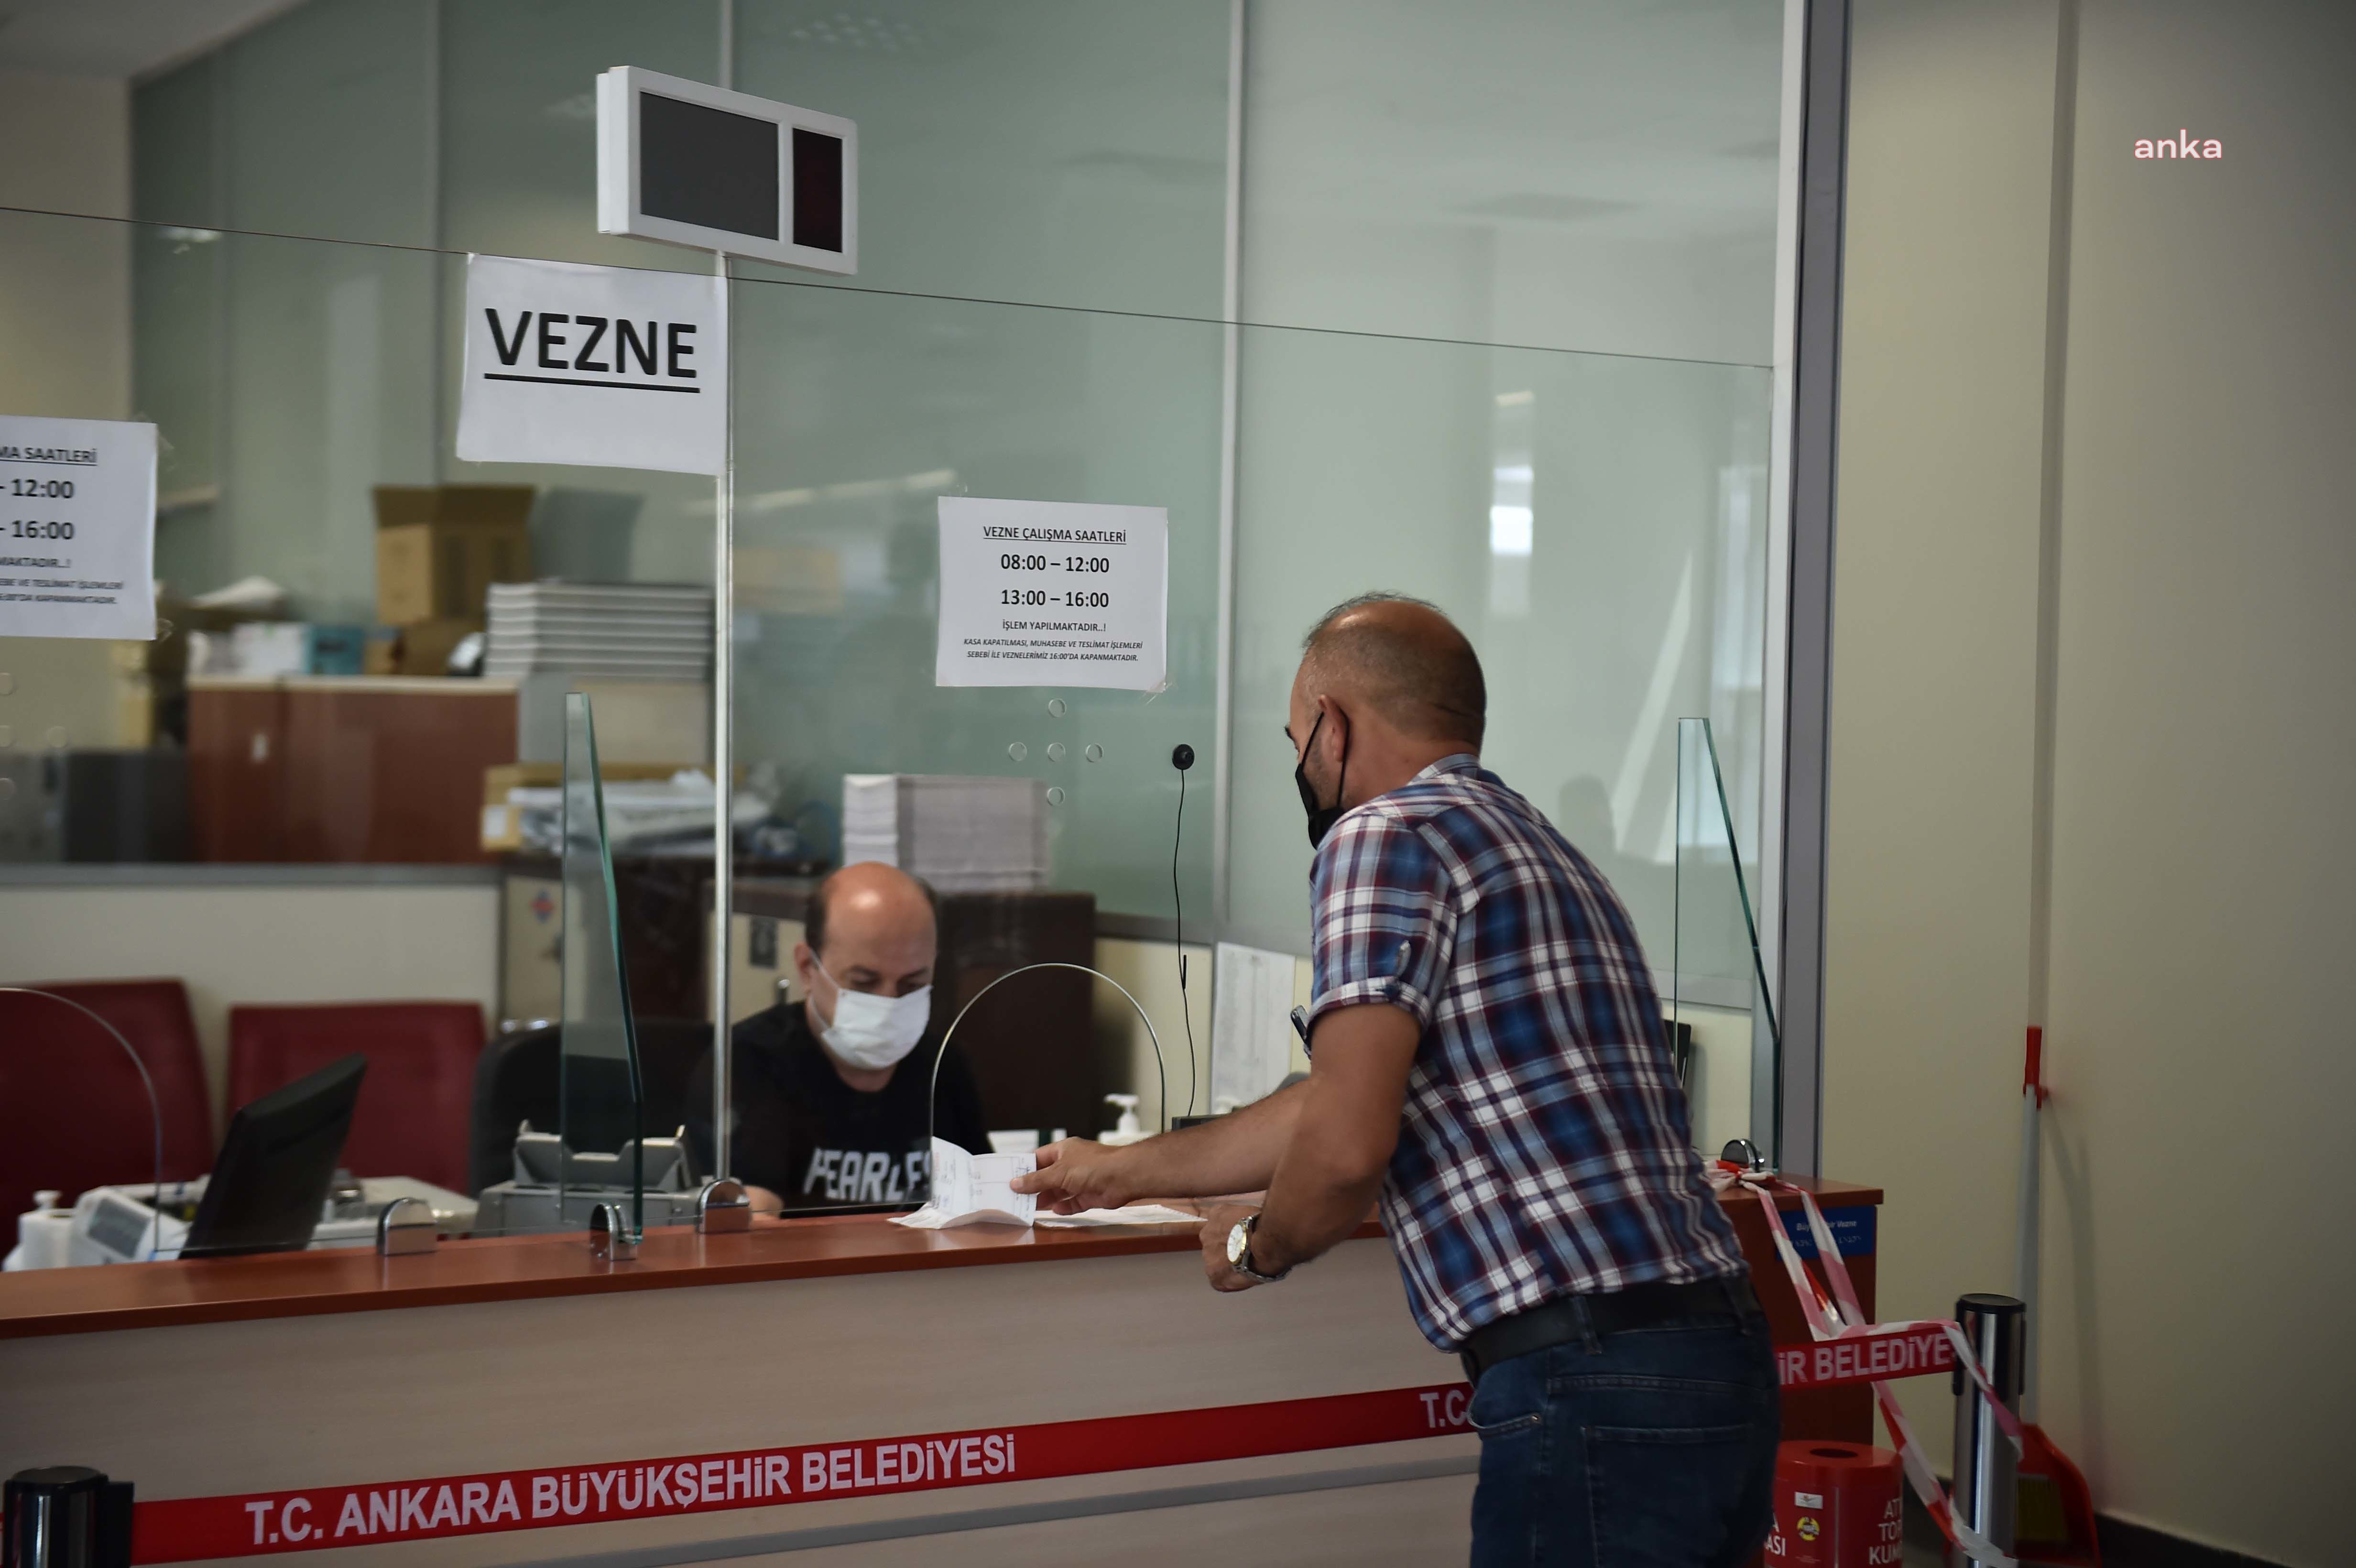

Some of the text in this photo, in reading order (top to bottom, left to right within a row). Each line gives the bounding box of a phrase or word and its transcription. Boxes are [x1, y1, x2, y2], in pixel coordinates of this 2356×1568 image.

[484, 307, 698, 378] VEZNE
[25, 447, 98, 463] SAATLERİ
[11, 479, 74, 499] 12:00
[11, 520, 74, 540] 16:00
[983, 526, 1126, 543] VEZNE ÇALIŞMA SAATLERİ
[1001, 554, 1047, 570] 08:00
[1065, 556, 1110, 573] 12:00
[1001, 589, 1046, 605] 13:00
[1065, 591, 1109, 608] 16:00
[1002, 619, 1106, 632] İŞLEM YAPILMAKTADIR..!
[982, 639, 1028, 647] KAPATILMASI,
[1030, 640, 1067, 648] MUHASEBE
[1079, 640, 1110, 648] TESLİMAT
[1110, 640, 1143, 650] İŞLEMLERİ
[991, 650, 1000, 658] İLE
[1002, 651, 1048, 659] VEZNELERİMİZ
[1815, 1333, 1955, 1381] BELEDİYE
[245, 1433, 1015, 1545] T.C. ANKARA BÜYÜKŞEHİR BELEDİYESİ
